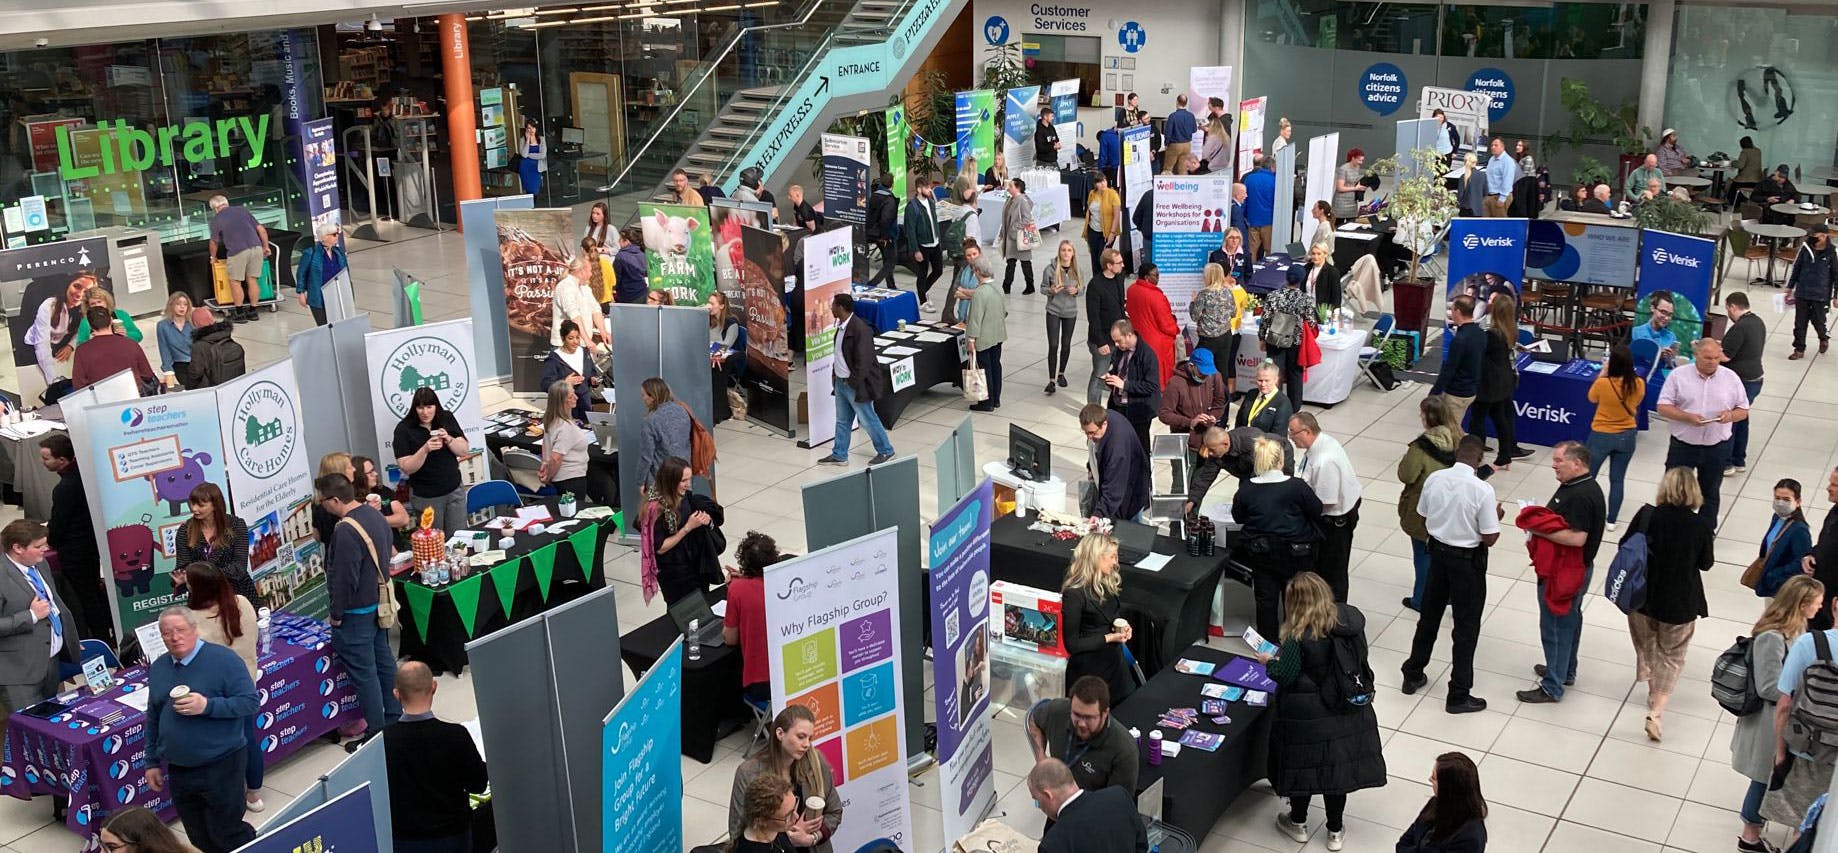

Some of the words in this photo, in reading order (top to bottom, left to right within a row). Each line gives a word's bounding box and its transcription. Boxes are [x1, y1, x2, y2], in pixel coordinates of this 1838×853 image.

[1031, 4, 1090, 18] Customer
[1034, 18, 1086, 31] Services
[281, 32, 291, 52] and
[453, 23, 464, 59] Library
[285, 55, 295, 84] Music
[838, 61, 880, 77] ENTRANCE
[1369, 72, 1398, 82] Norfolk
[1475, 78, 1505, 88] Norfolk
[1366, 82, 1401, 93] citizens
[1472, 88, 1508, 99] itizens
[288, 86, 299, 119] Books,
[1367, 93, 1398, 103] advice
[1427, 90, 1485, 111] PRIORY
[55, 113, 270, 180] Library
[1156, 181, 1199, 192] wellbeing
[1171, 203, 1202, 211] Wellbeing
[1156, 211, 1191, 219] Workshops
[1155, 219, 1200, 227] Organisations
[1480, 237, 1514, 247] Verisk
[16, 257, 75, 271] PERENCO
[832, 252, 851, 268] WORK
[1668, 253, 1699, 268] Verisk
[507, 267, 524, 277] IT'S
[526, 265, 543, 275] NOT
[546, 265, 552, 274] A
[660, 261, 696, 277] FARM
[722, 269, 733, 280] BE
[514, 284, 554, 299] Passi
[391, 343, 457, 371] Hollyman
[895, 371, 912, 386] WORK
[443, 381, 465, 411] mes
[147, 404, 167, 414] step
[238, 388, 286, 422] Hollyman
[1513, 400, 1571, 424] Verisk
[147, 411, 186, 423] teachers
[240, 447, 263, 473] Care
[265, 426, 293, 473] Homes
[239, 486, 273, 509] Residential
[272, 480, 287, 492] Care
[256, 502, 265, 512] for
[265, 498, 275, 508] the
[275, 488, 296, 503] Elderly
[793, 581, 818, 594] Flagship
[1609, 569, 1627, 603] adidas
[780, 622, 804, 637] Why
[807, 605, 850, 628] Flagship
[852, 590, 888, 611] Group?
[265, 656, 294, 675] teachers
[336, 672, 349, 682] ste
[270, 679, 286, 691] step
[271, 679, 300, 698] teachers
[340, 694, 357, 705] step
[275, 702, 291, 714] step
[276, 703, 306, 722] teachers
[124, 724, 143, 737] step
[126, 731, 145, 745] teac
[280, 725, 296, 738] step
[613, 771, 627, 797] Join
[628, 738, 654, 775] Flagship
[614, 783, 634, 812] Group
[635, 767, 644, 786] for
[645, 761, 650, 772] a
[143, 796, 161, 810] step
[614, 800, 635, 833] Bright
[635, 774, 656, 805] Future
